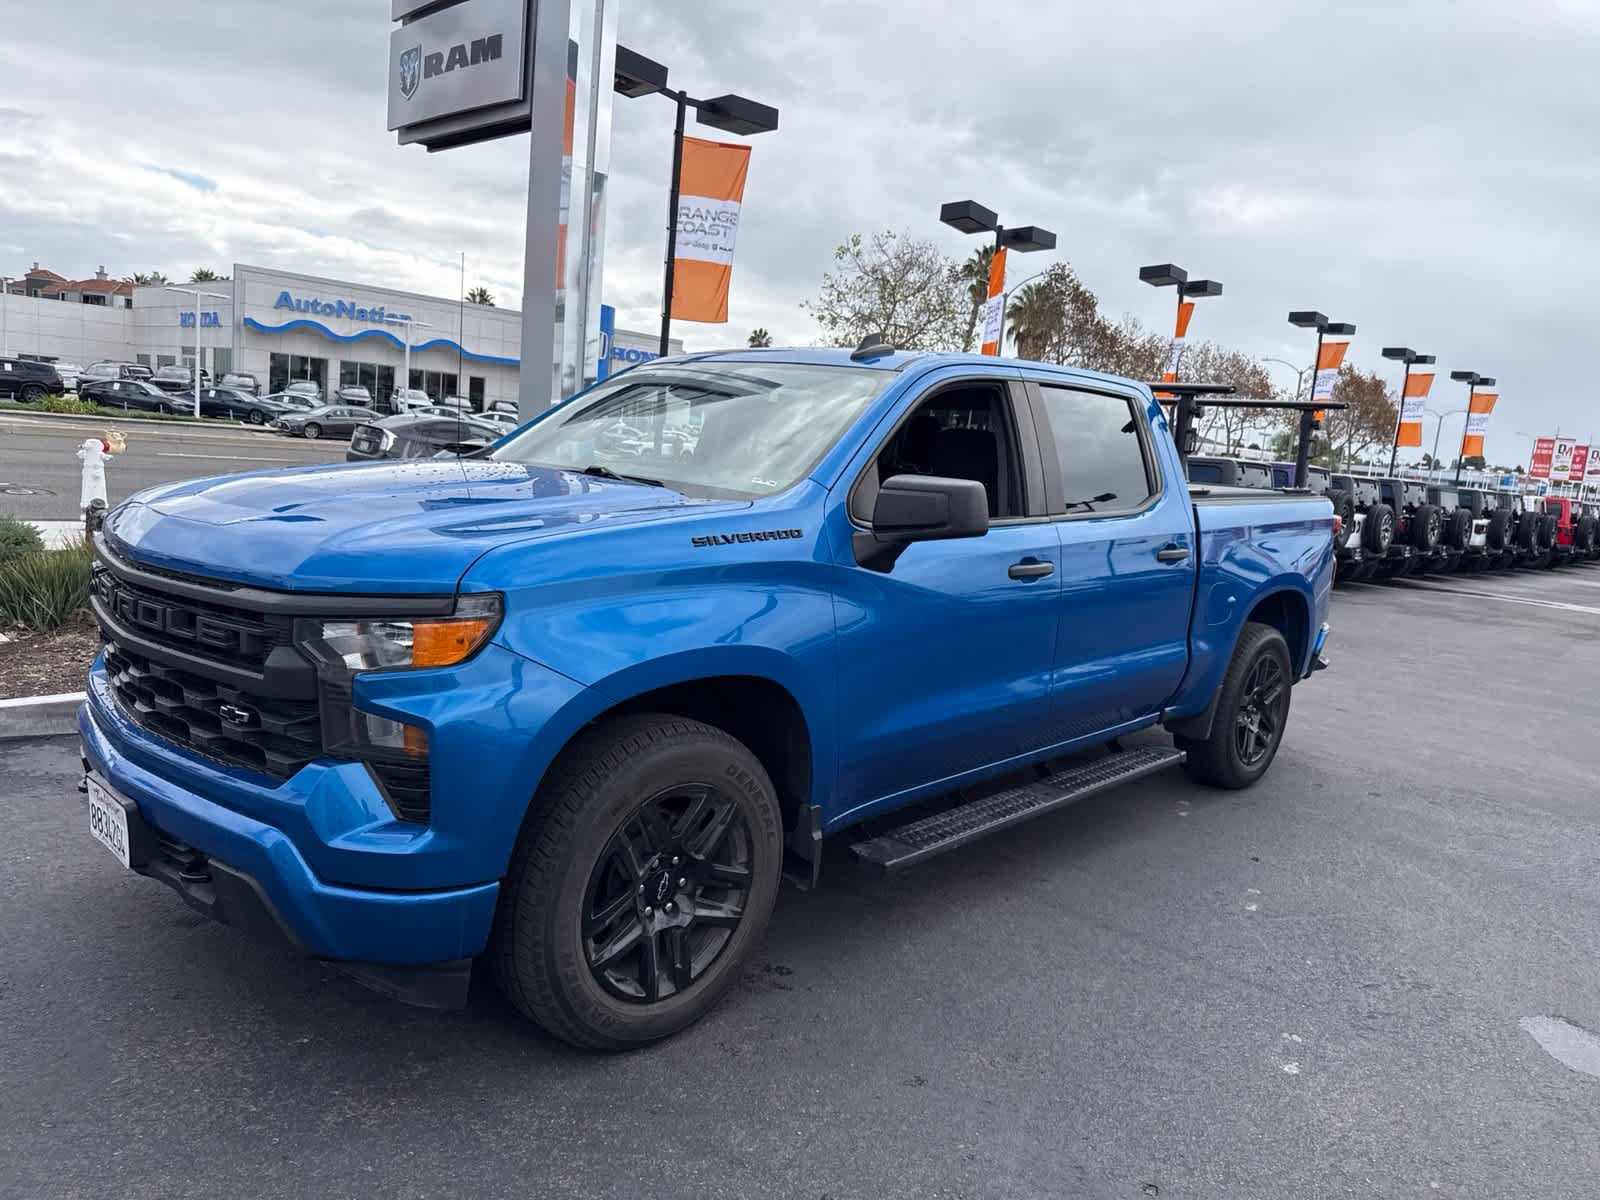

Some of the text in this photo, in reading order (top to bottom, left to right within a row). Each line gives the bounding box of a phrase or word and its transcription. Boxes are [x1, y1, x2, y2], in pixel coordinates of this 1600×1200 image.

[423, 33, 503, 80] RAM
[679, 206, 738, 226] RANGE
[273, 290, 412, 327] AutoNation
[691, 528, 804, 548] SILVERADO
